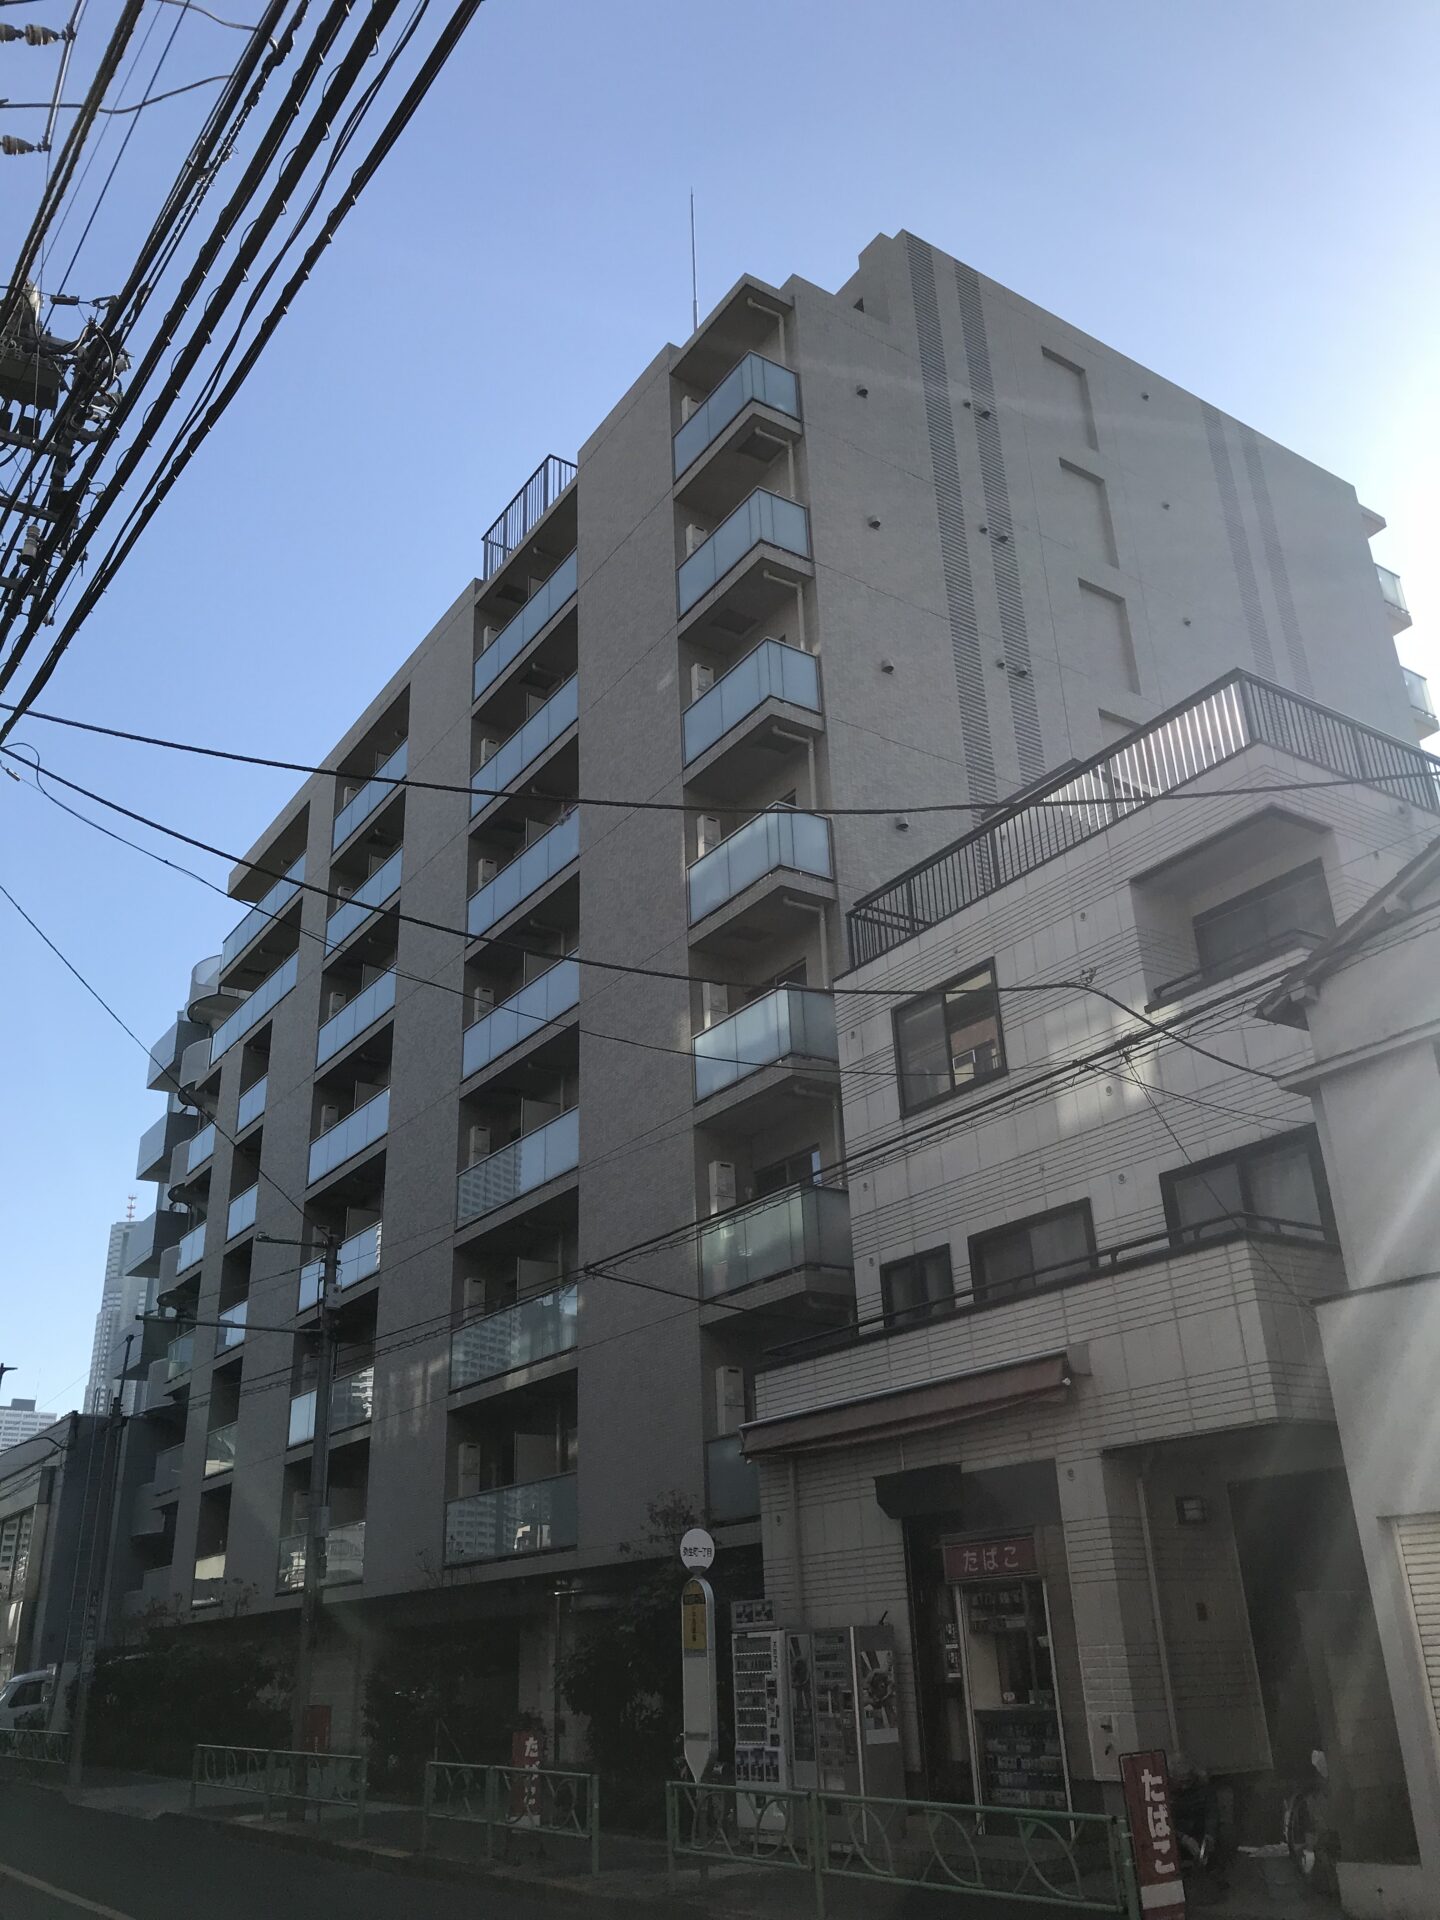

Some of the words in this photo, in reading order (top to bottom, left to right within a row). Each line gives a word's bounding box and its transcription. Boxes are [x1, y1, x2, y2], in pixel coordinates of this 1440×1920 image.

[963, 1547, 1018, 1571] たばこ
[1141, 1768, 1175, 1874] たばこ
